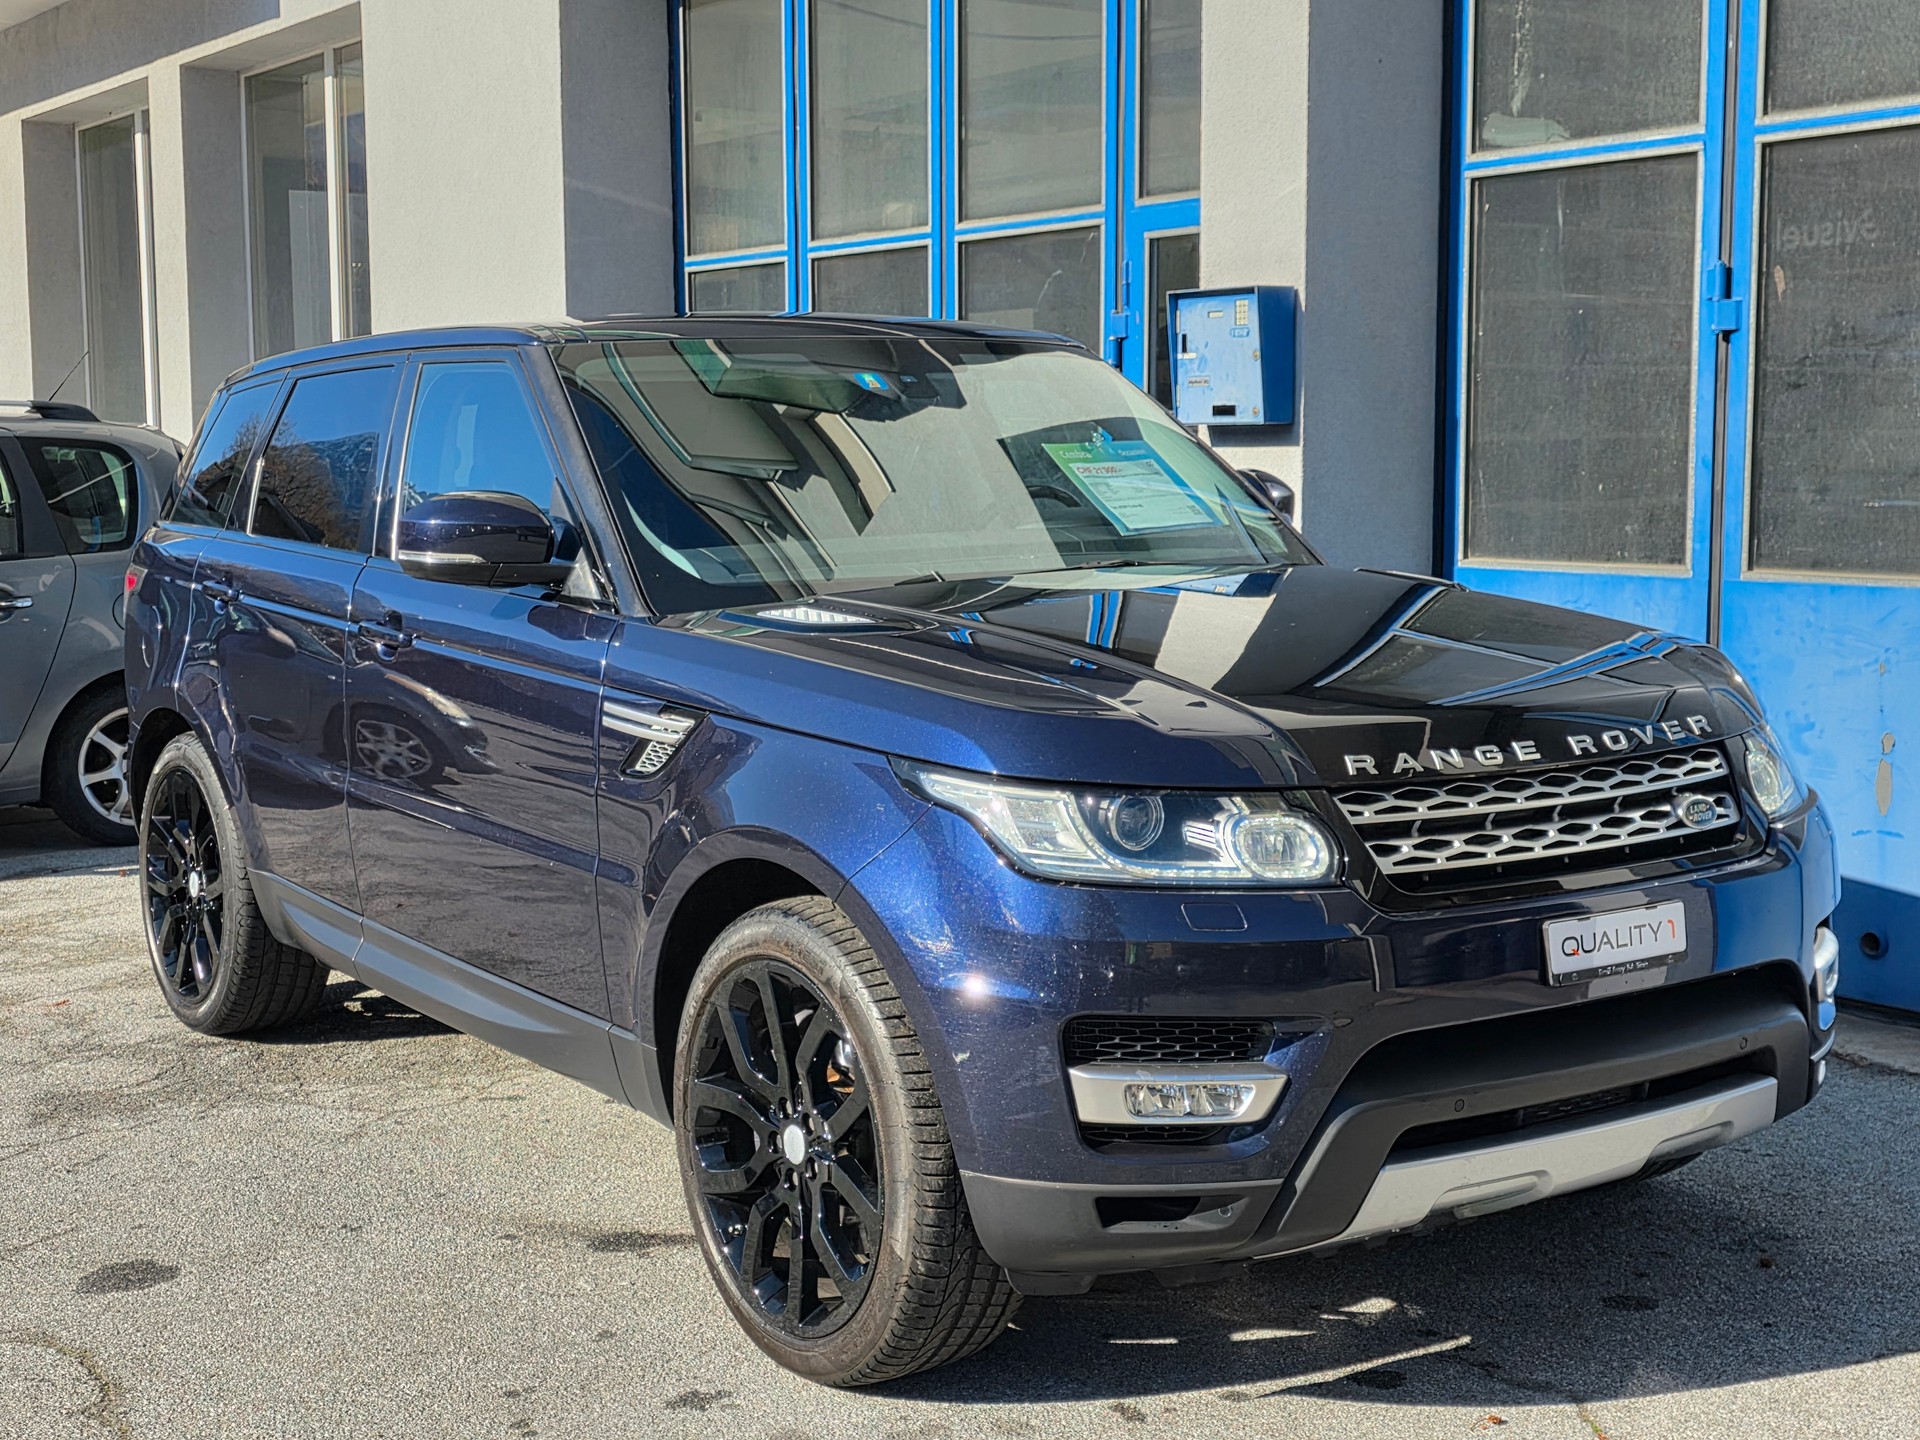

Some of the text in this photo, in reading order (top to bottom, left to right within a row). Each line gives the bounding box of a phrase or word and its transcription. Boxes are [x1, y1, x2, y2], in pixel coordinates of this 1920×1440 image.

[1344, 714, 1713, 776] RANGE ROVER
[1690, 803, 1707, 814] LAND
[1692, 811, 1713, 823] ROVER
